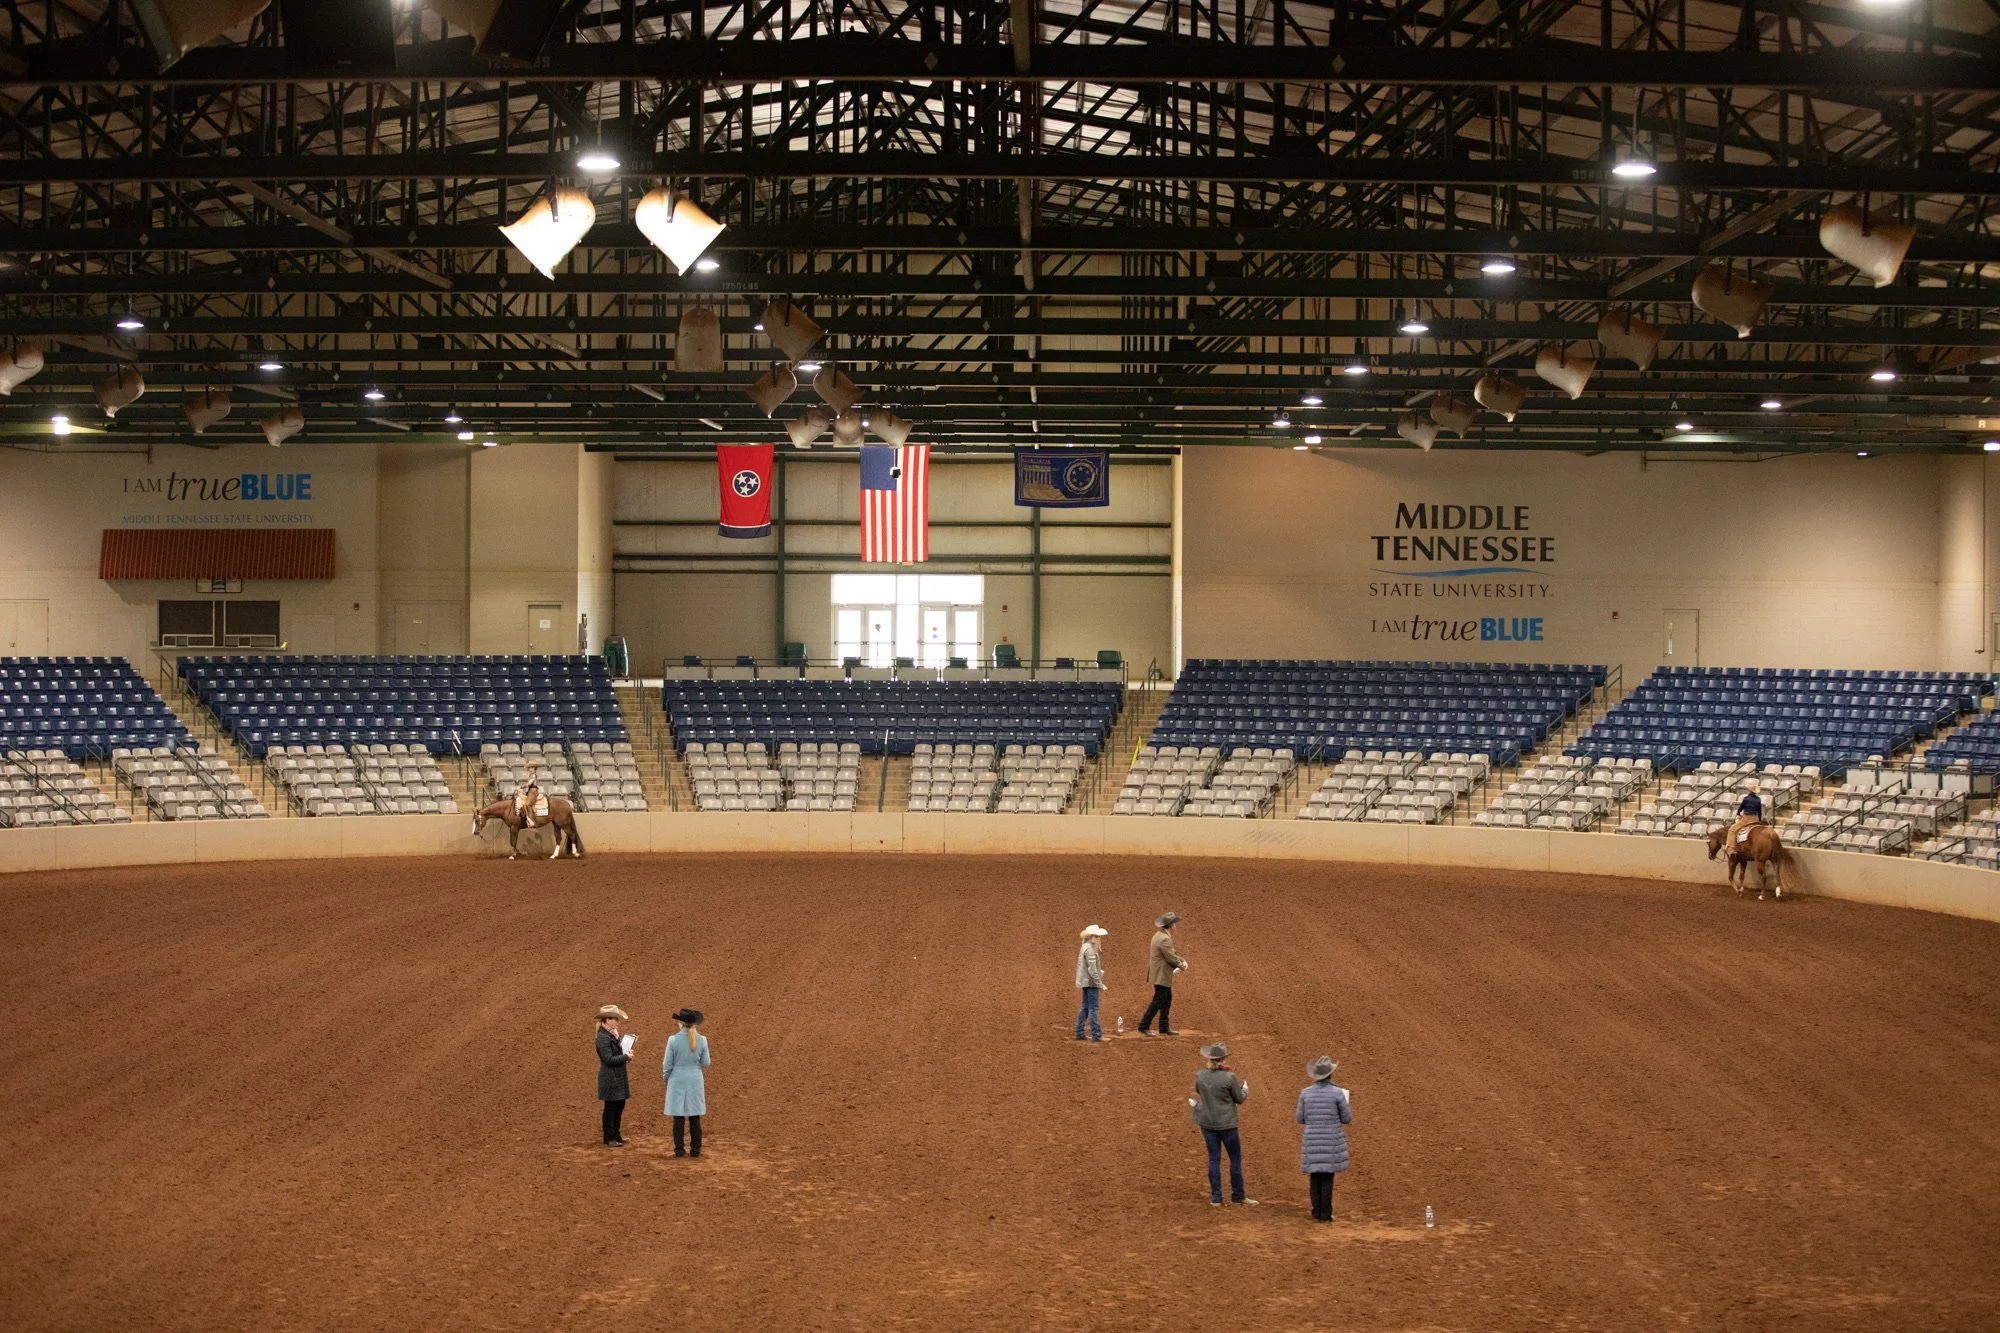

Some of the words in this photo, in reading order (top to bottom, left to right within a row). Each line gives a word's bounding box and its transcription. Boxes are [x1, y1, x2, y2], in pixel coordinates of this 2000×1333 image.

[1370, 355, 1380, 366] N
[1670, 400, 1679, 410] A
[1978, 419, 1987, 429] R
[123, 479, 128, 492] I
[133, 479, 162, 493] AM
[122, 514, 162, 525] MIDDLE
[166, 514, 221, 525] TENNESSEE
[223, 514, 252, 525] STATE
[256, 514, 314, 525] UNIVERSITY
[1395, 502, 1529, 530] MIDDLE
[1371, 535, 1555, 562] TENNESSEE
[1369, 582, 1423, 597] STATE
[1372, 620, 1376, 632] I
[1380, 619, 1407, 633] AM
